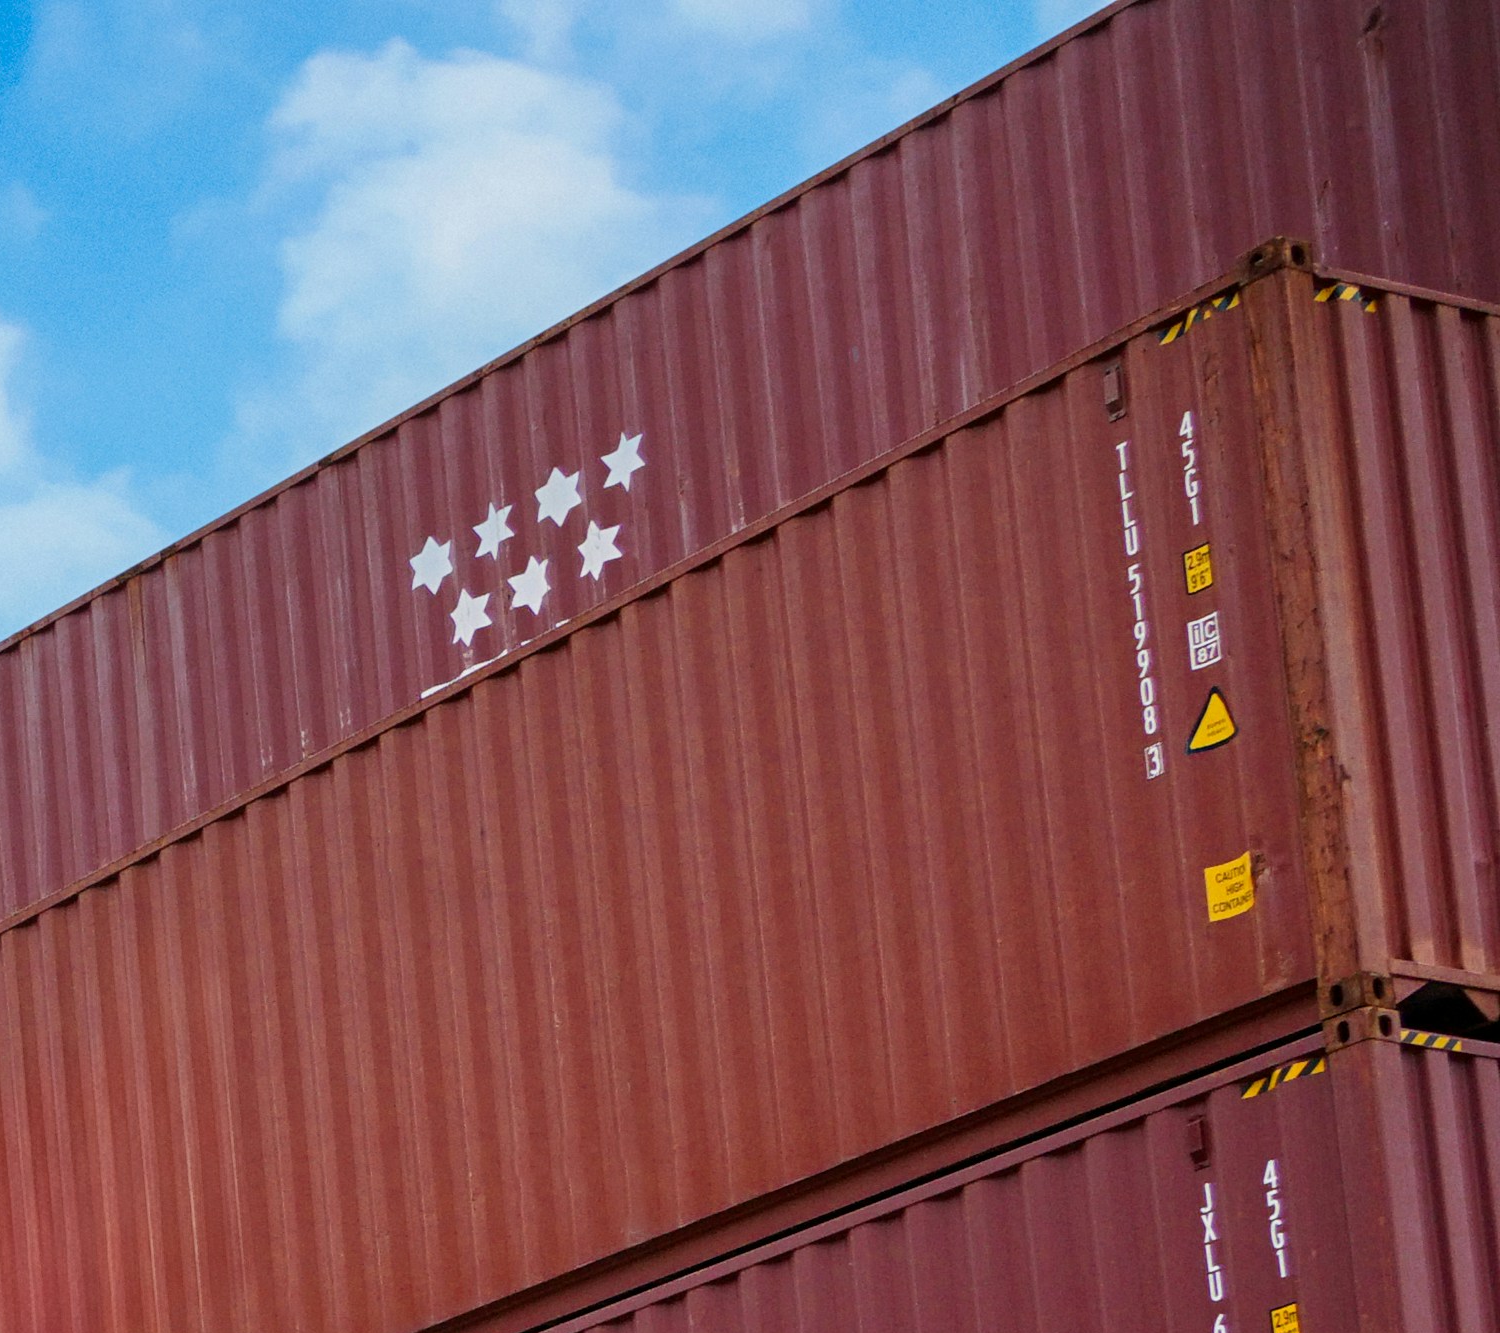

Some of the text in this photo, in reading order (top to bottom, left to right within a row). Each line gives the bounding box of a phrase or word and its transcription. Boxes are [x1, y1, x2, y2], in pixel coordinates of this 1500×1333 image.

[1179, 411, 1201, 525] 45G1
[1116, 441, 1140, 556] TLLU
[1128, 563, 1156, 735] 519908
[1197, 644, 1217, 663] 87
[1200, 1182, 1224, 1302] JXLU
[1263, 1159, 1288, 1279] 45G1
